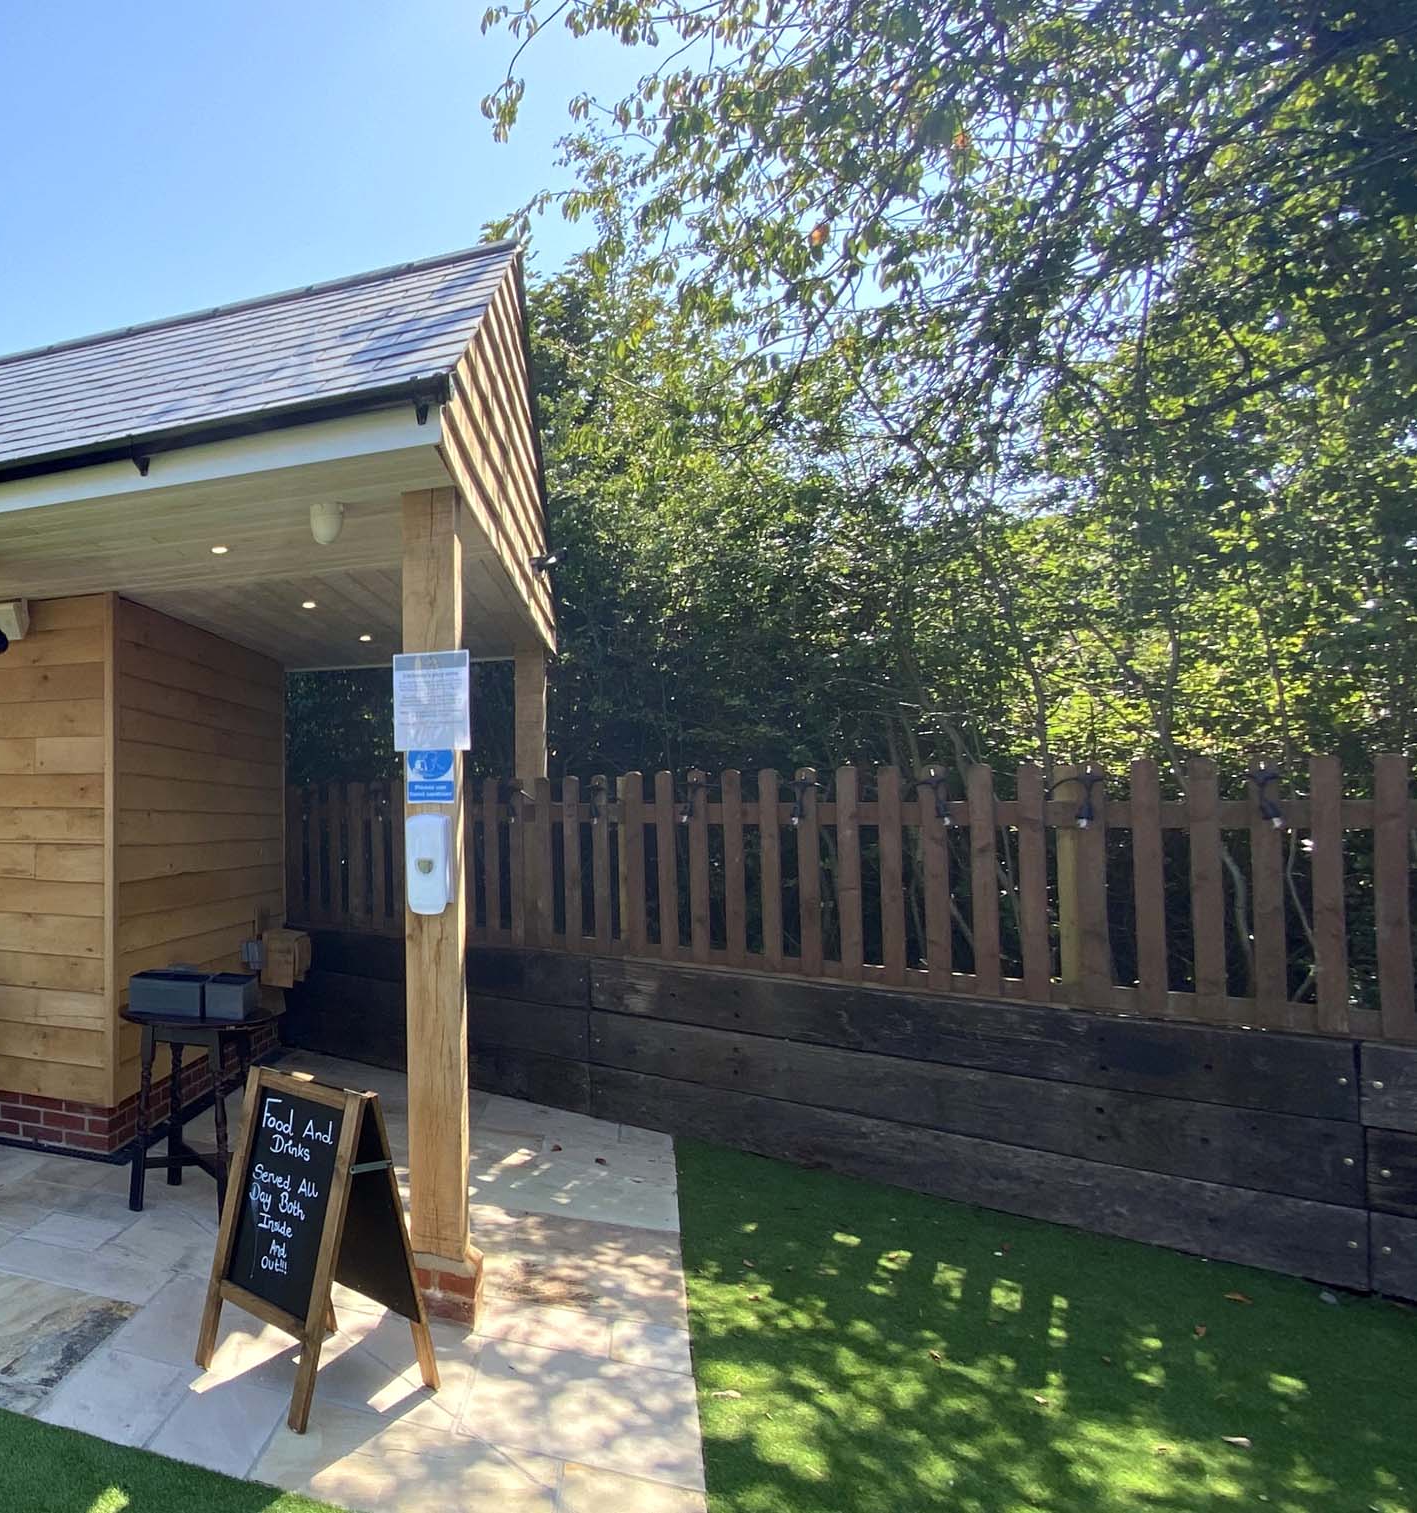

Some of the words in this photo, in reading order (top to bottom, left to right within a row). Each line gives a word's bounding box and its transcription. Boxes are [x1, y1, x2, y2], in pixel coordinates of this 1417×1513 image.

[261, 1097, 294, 1137] Food
[302, 1119, 334, 1145] And
[269, 1133, 311, 1162] Drinks
[252, 1163, 292, 1192] Served
[297, 1177, 319, 1199] All
[249, 1182, 272, 1212] Day
[279, 1192, 306, 1221] Both
[257, 1212, 293, 1239] Inside
[269, 1239, 287, 1259] And
